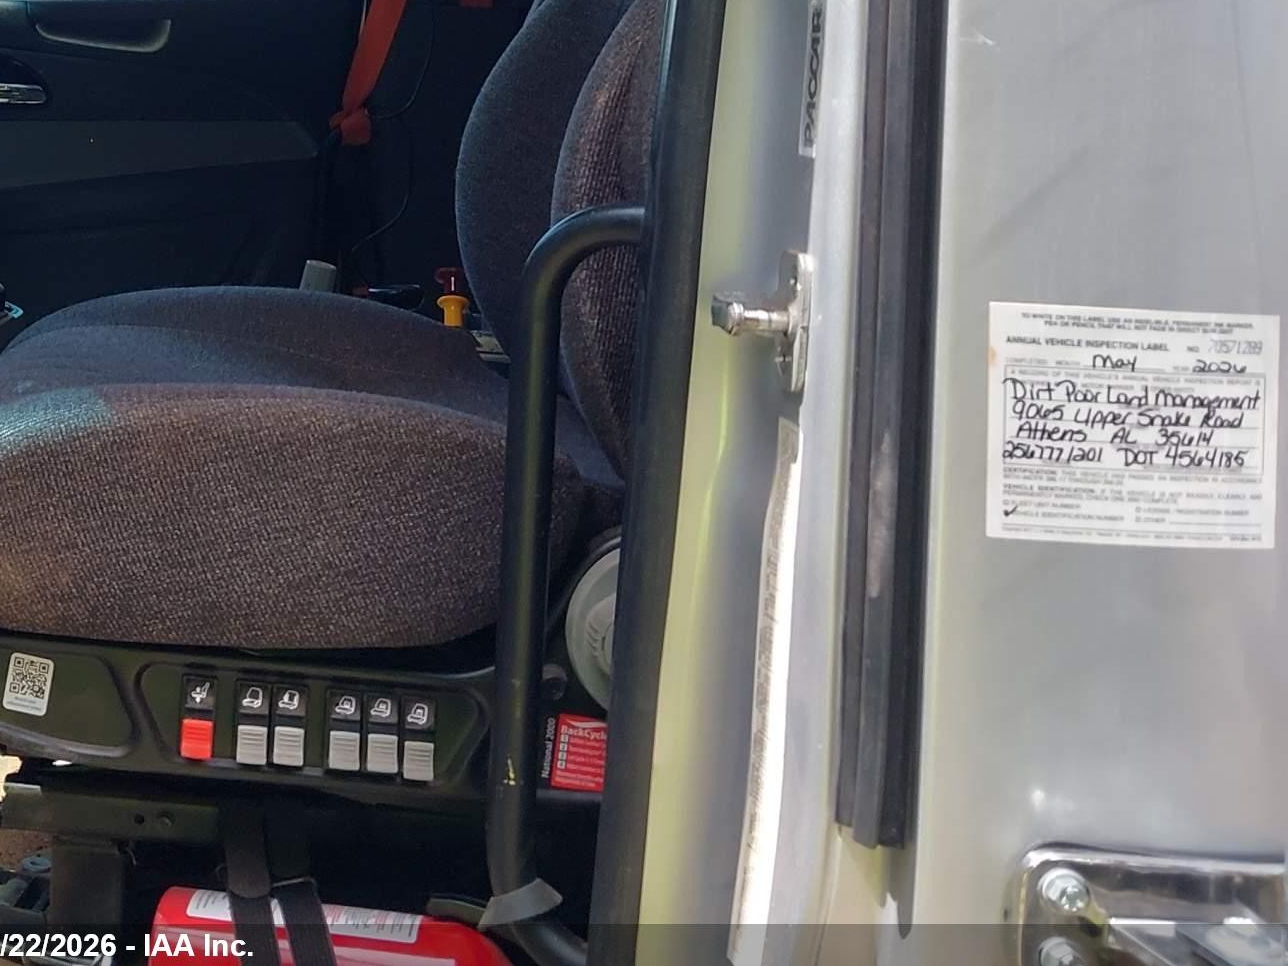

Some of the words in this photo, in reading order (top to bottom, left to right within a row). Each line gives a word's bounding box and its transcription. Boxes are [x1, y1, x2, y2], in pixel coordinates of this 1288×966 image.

[1006, 335, 1042, 346] ANNUAL
[1045, 337, 1083, 348] VEHICLE
[1085, 339, 1139, 350] INSPECTION
[1140, 342, 1170, 352] LABEL
[1092, 353, 1137, 372] May
[1002, 377, 1055, 401] Dirt
[1055, 379, 1101, 403] Poor
[1106, 384, 1148, 408] Land
[1012, 399, 1066, 421] 9065
[1074, 407, 1132, 429] Upper
[1137, 408, 1191, 427] Snake
[1200, 408, 1244, 429] Road
[1015, 420, 1087, 442] Athens
[1110, 426, 1137, 445] AL
[1116, 447, 1158, 467] DOT
[545, 717, 556, 740] 2000
[561, 725, 607, 740] BackCycl
[540, 740, 553, 778] National
